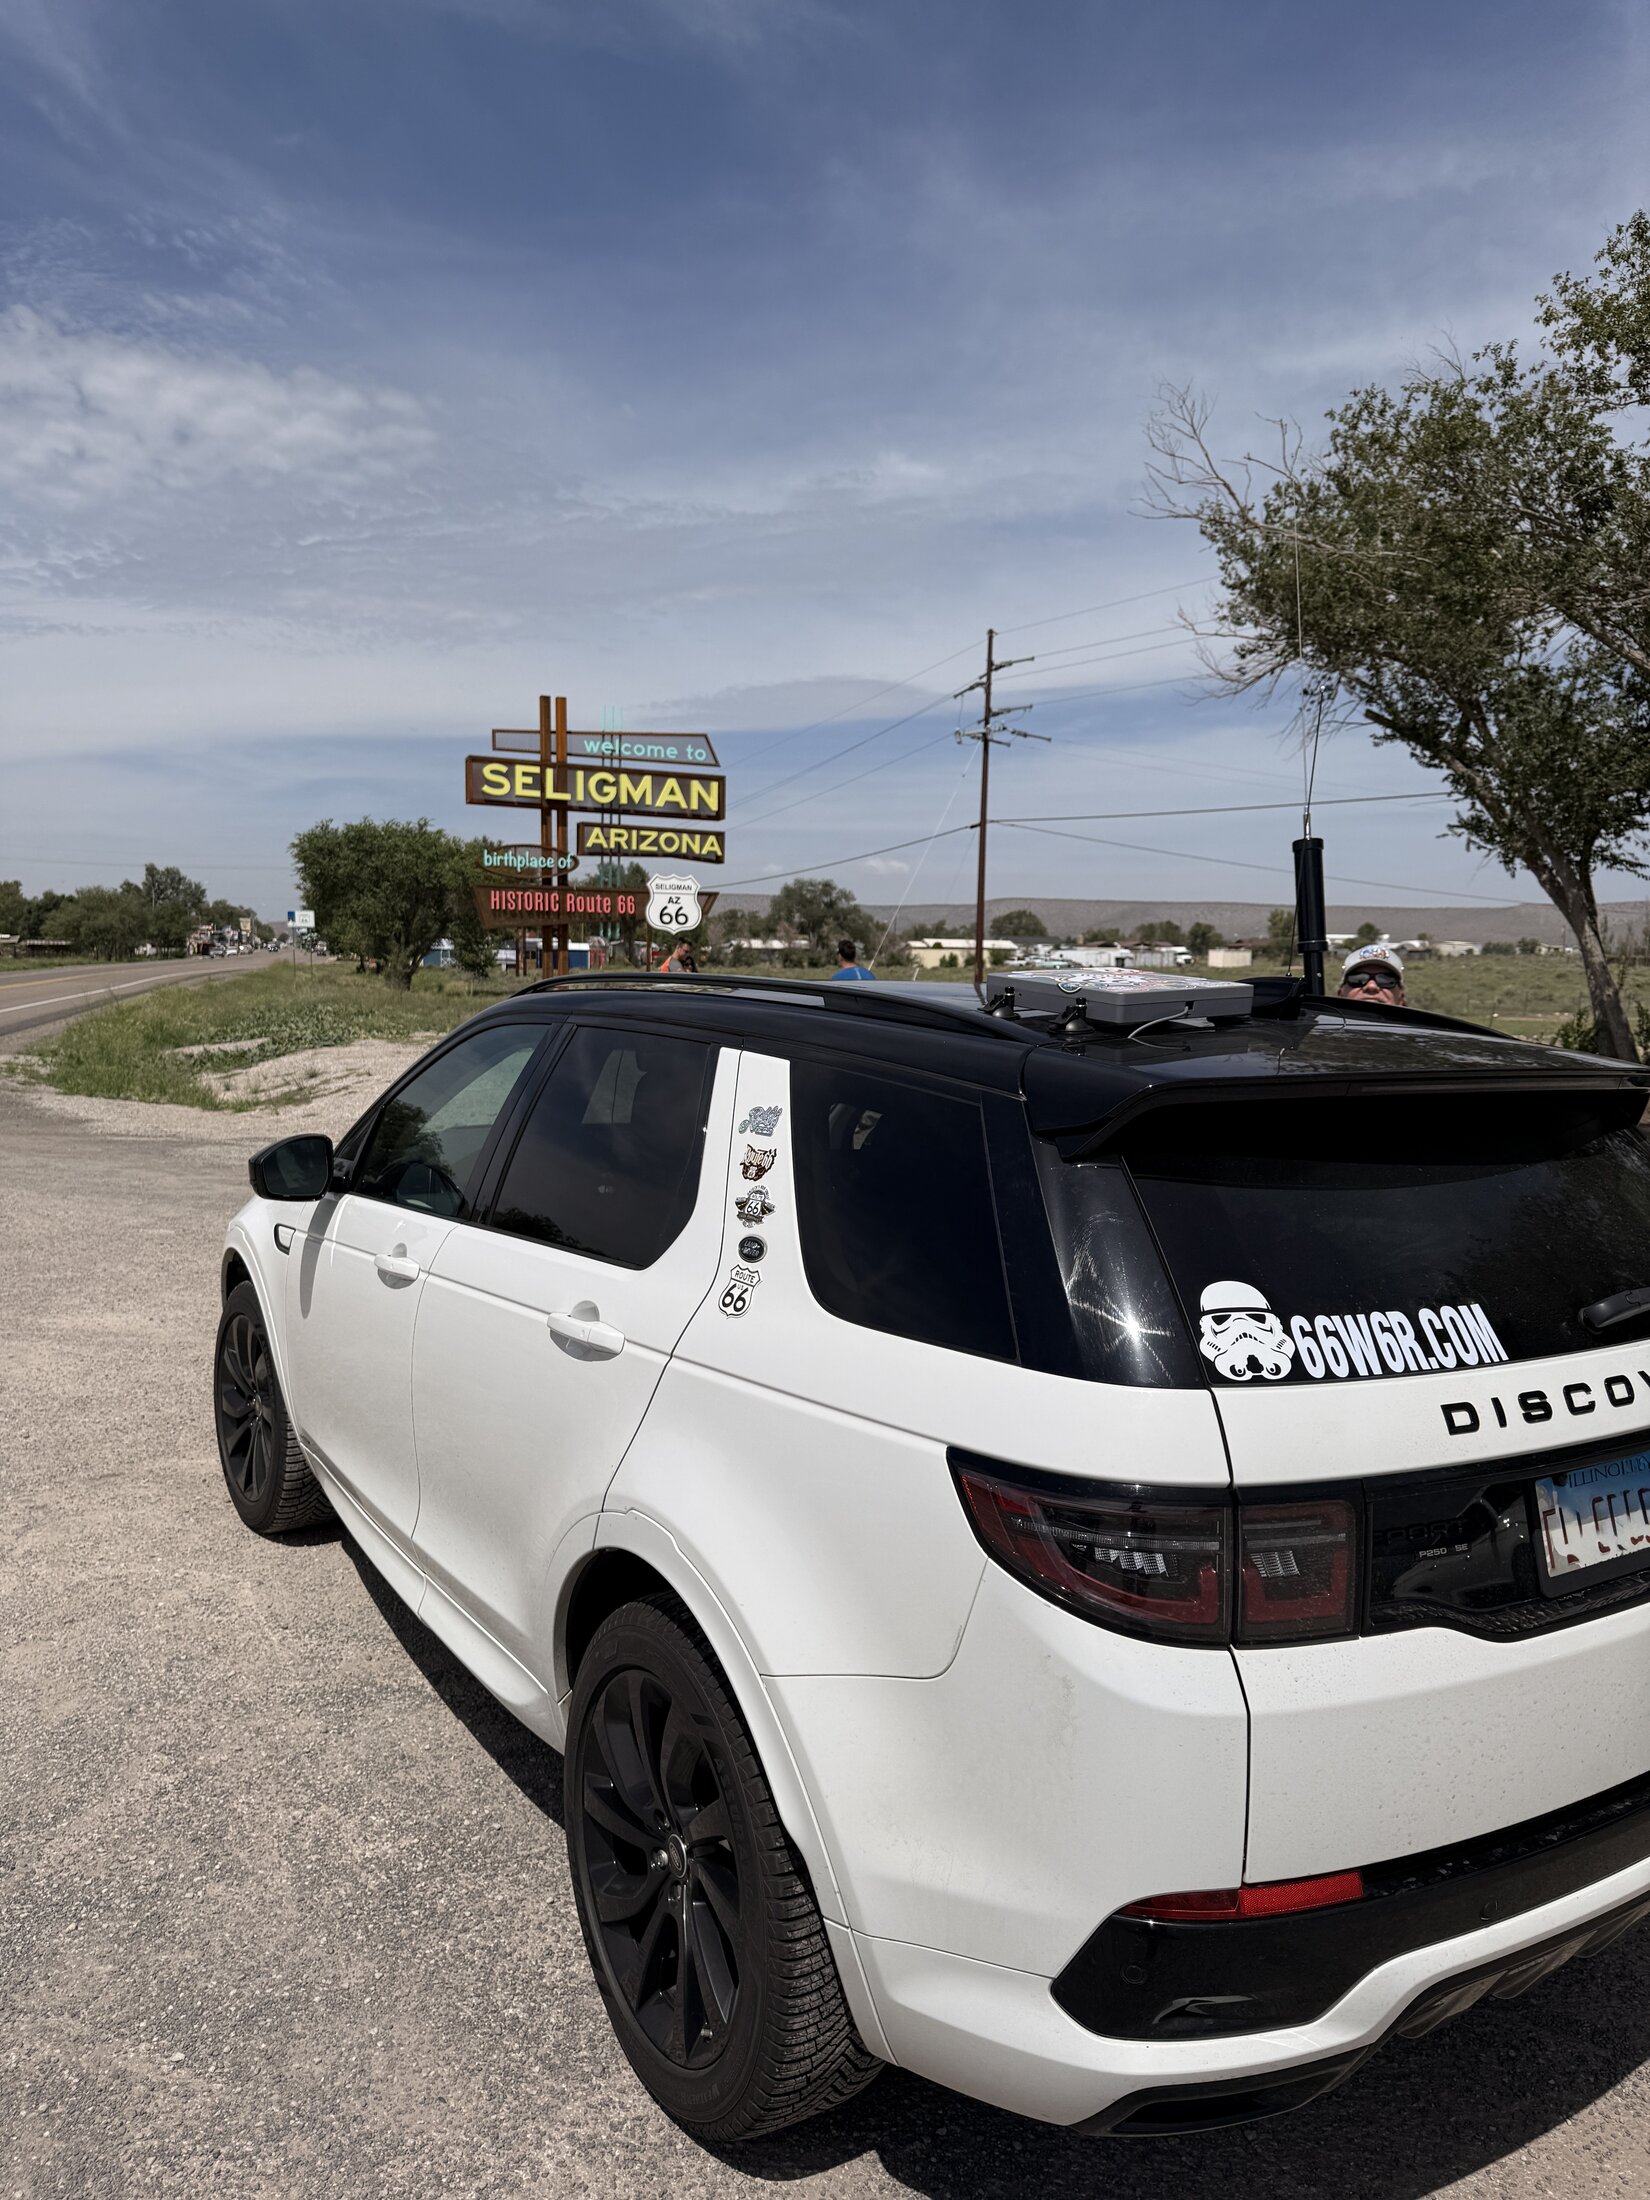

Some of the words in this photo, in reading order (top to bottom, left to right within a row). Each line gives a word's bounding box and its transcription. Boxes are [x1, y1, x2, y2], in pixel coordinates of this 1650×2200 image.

[584, 738, 678, 760] welcome
[686, 744, 707, 762] to
[482, 763, 719, 811] SELIGMAN
[586, 827, 723, 857] ARIZONA
[483, 849, 554, 873] birthplace
[557, 851, 574, 869] of
[655, 883, 693, 892] SELIGMAN
[490, 890, 560, 913] HISTORIC
[566, 893, 611, 914] Route
[617, 894, 636, 915] 66
[667, 895, 682, 905] AZ
[659, 905, 689, 925] 66
[746, 1201, 760, 1215] 66
[735, 1270, 756, 1284] ROUTE
[722, 1283, 749, 1312] 66
[1290, 1303, 1509, 1379] 66W6R.COM
